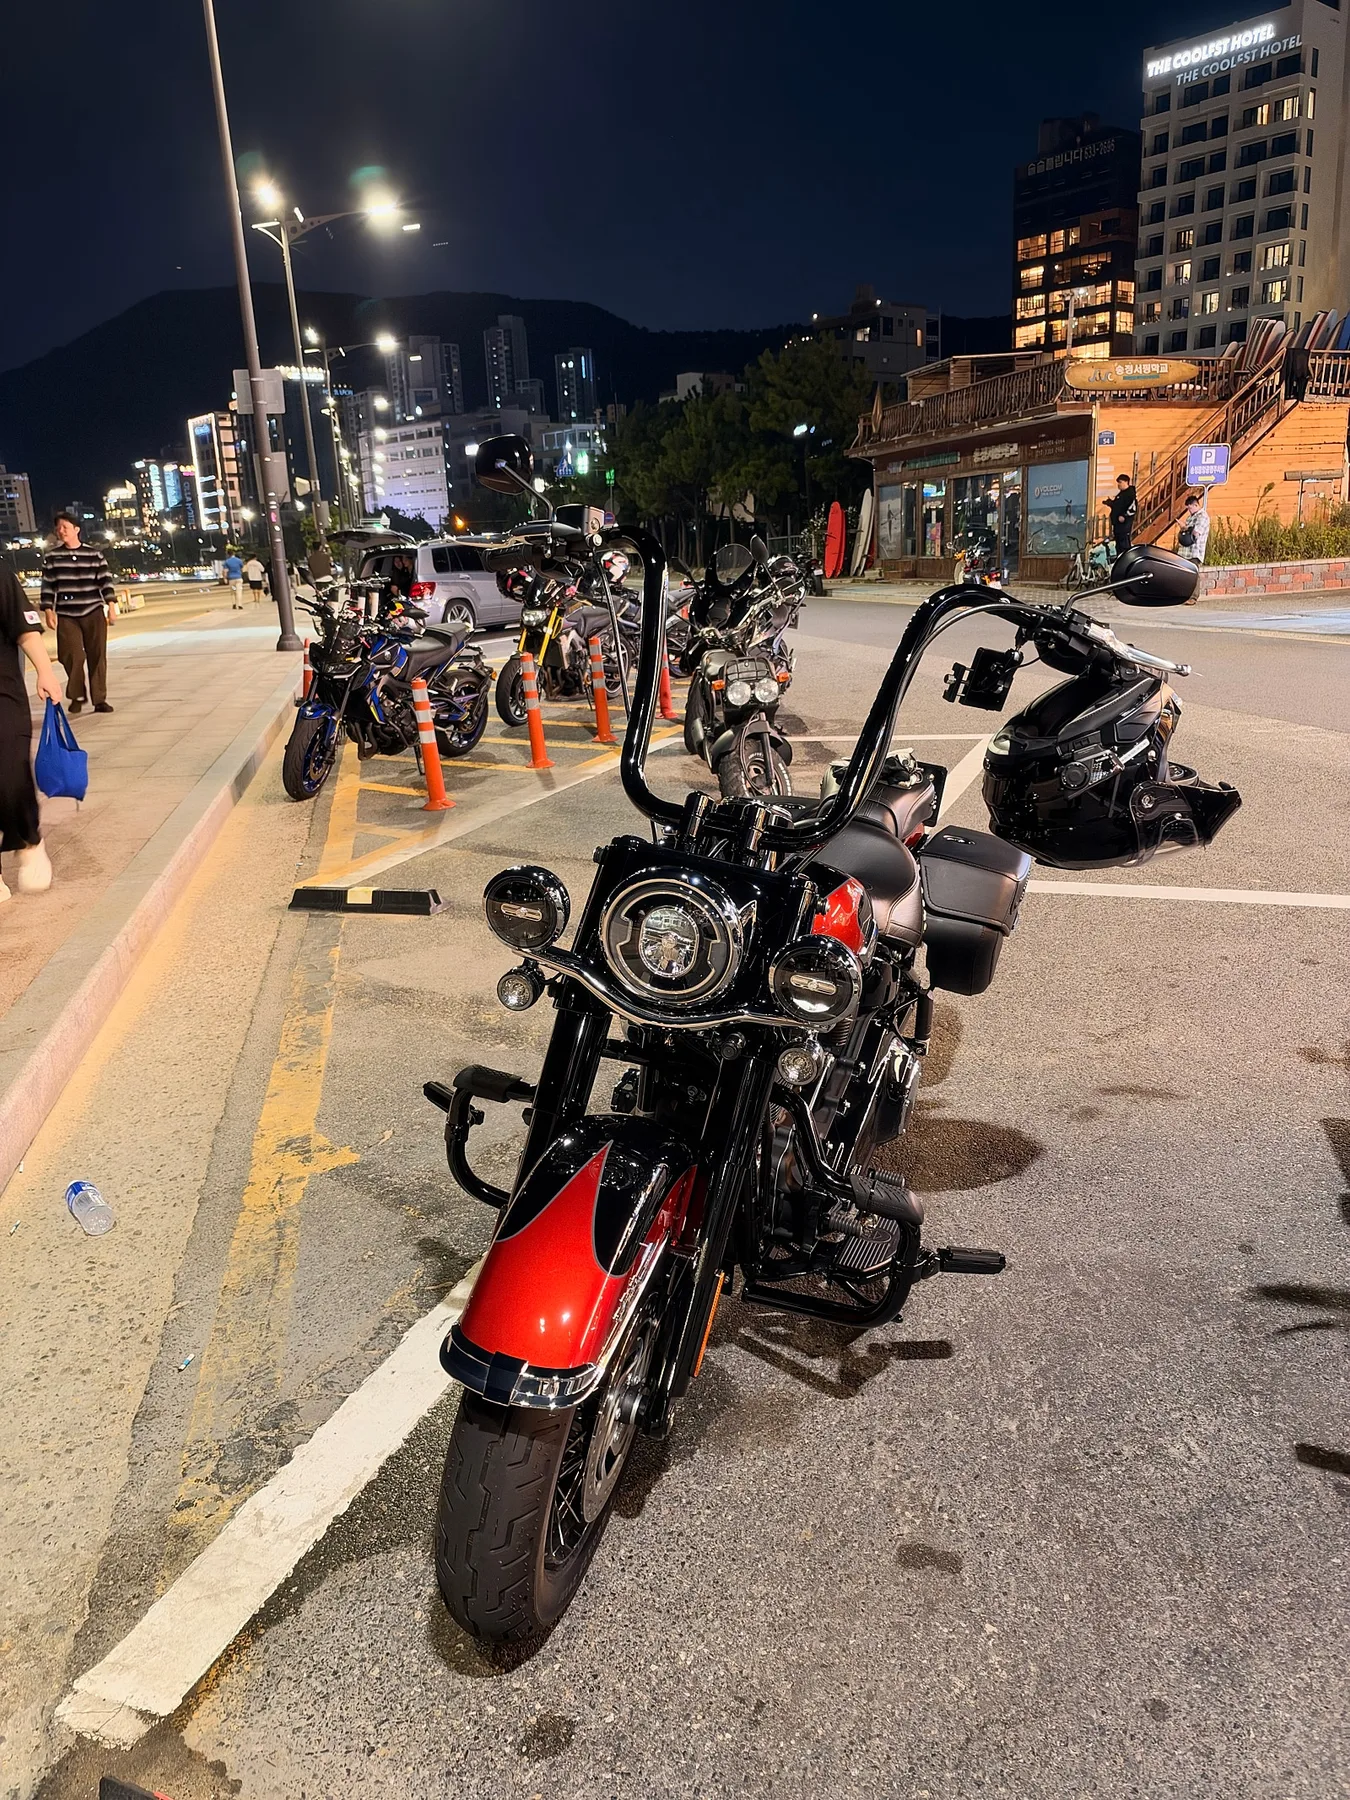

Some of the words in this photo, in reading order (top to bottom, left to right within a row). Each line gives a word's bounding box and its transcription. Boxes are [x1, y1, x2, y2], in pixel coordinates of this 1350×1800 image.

[1148, 58, 1172, 77] THE
[1230, 24, 1276, 50] HOTEL
[1176, 69, 1198, 86] THE
[1201, 49, 1257, 77] COOLEST
[1260, 34, 1303, 59] HOTEL
[1205, 451, 1213, 462] P
[1040, 484, 1063, 492] VOLCOM
